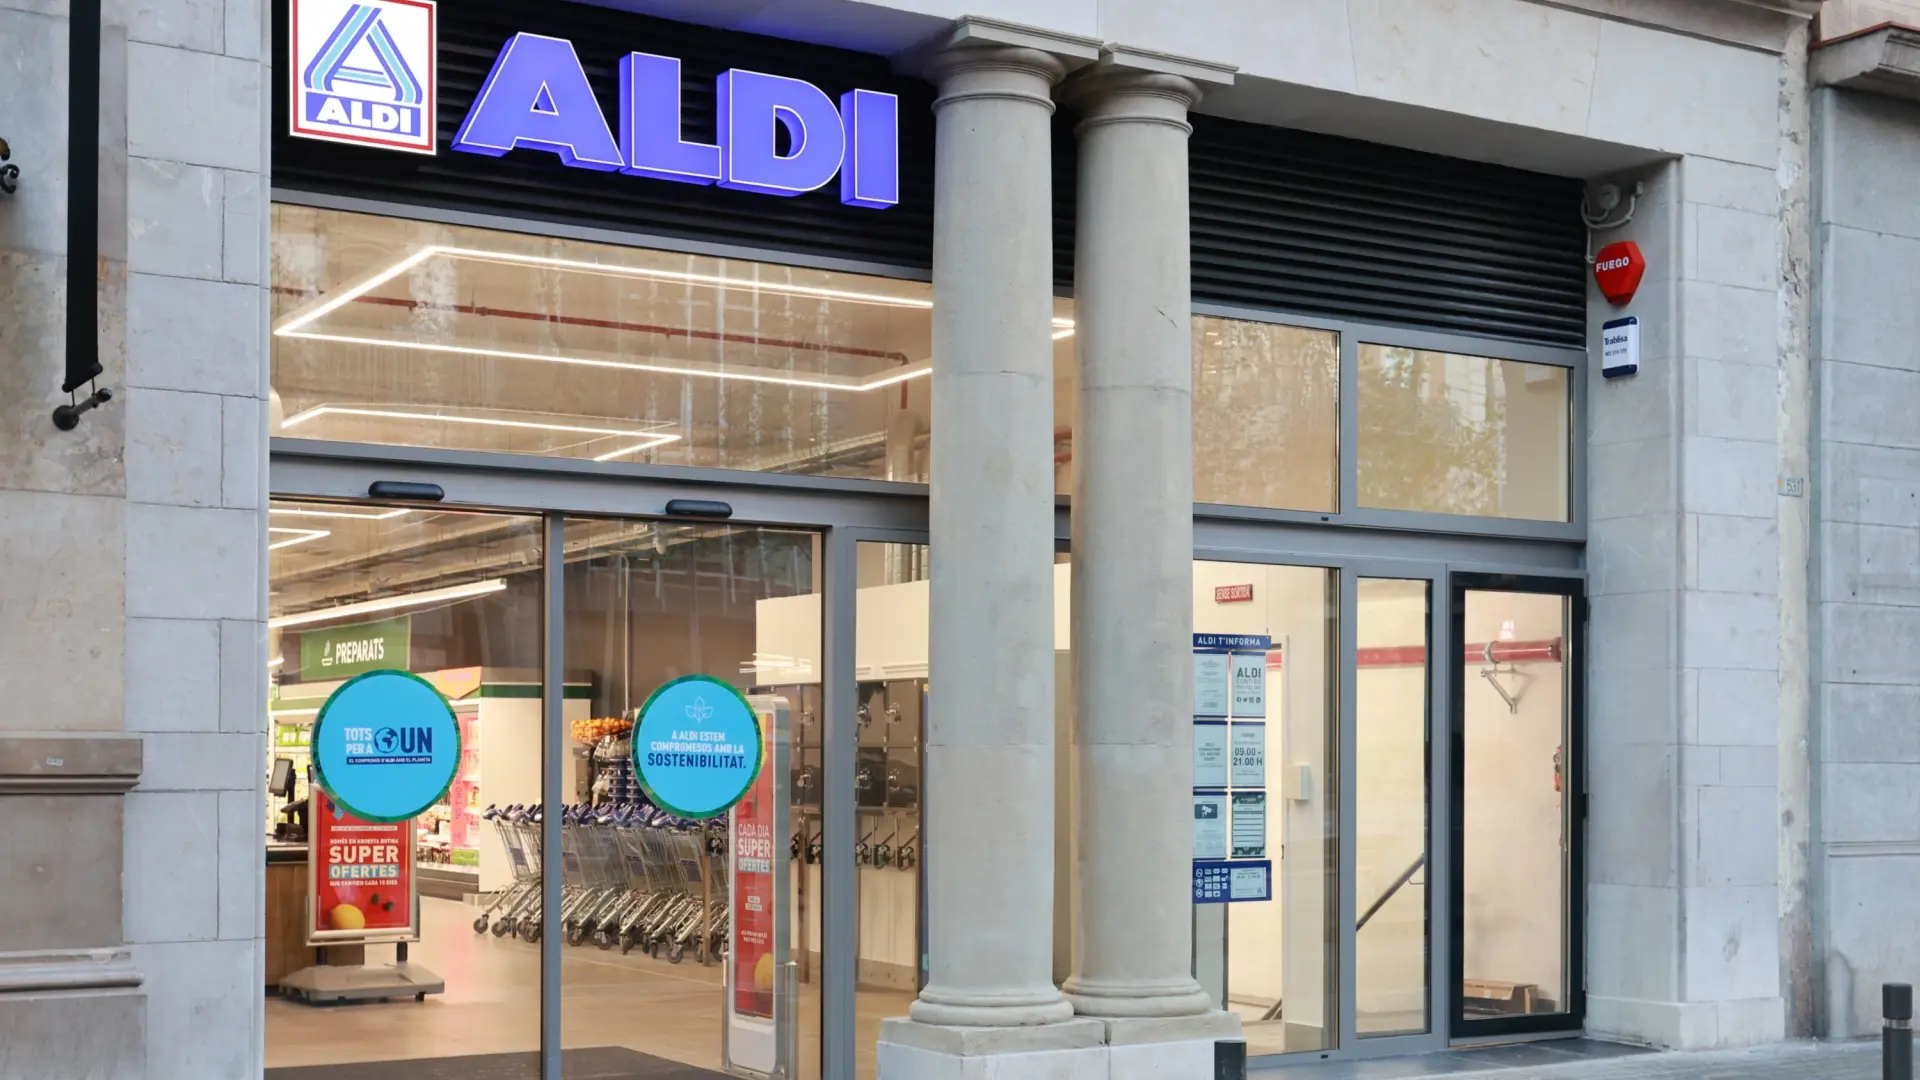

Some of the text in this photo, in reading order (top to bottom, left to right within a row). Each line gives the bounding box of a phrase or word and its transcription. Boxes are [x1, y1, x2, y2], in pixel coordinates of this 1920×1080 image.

[316, 97, 412, 134] ALDI
[452, 31, 898, 209] ALDI
[1595, 256, 1630, 272] FUEGO
[1604, 335, 1628, 346] Trablisa
[1197, 636, 1261, 646] ALDI T'INFORMA
[335, 637, 385, 665] PREPARATS
[1236, 667, 1262, 678] ALDI
[344, 727, 373, 741] TOTS
[400, 727, 432, 753] UN
[671, 730, 725, 742] A ALDI ESTEM
[346, 743, 374, 754] PER A
[650, 741, 744, 754] COMPROMESOS AMB LA
[1234, 747, 1256, 756] 09.00
[647, 753, 747, 768] SOSTENIBILITAT.
[1233, 757, 1255, 766] 21.00
[738, 823, 770, 837] CADA DIA
[329, 845, 399, 863] SUPER
[738, 838, 771, 857] SUPER
[331, 864, 397, 878] OFERTES
[739, 857, 770, 872] OFERTES
